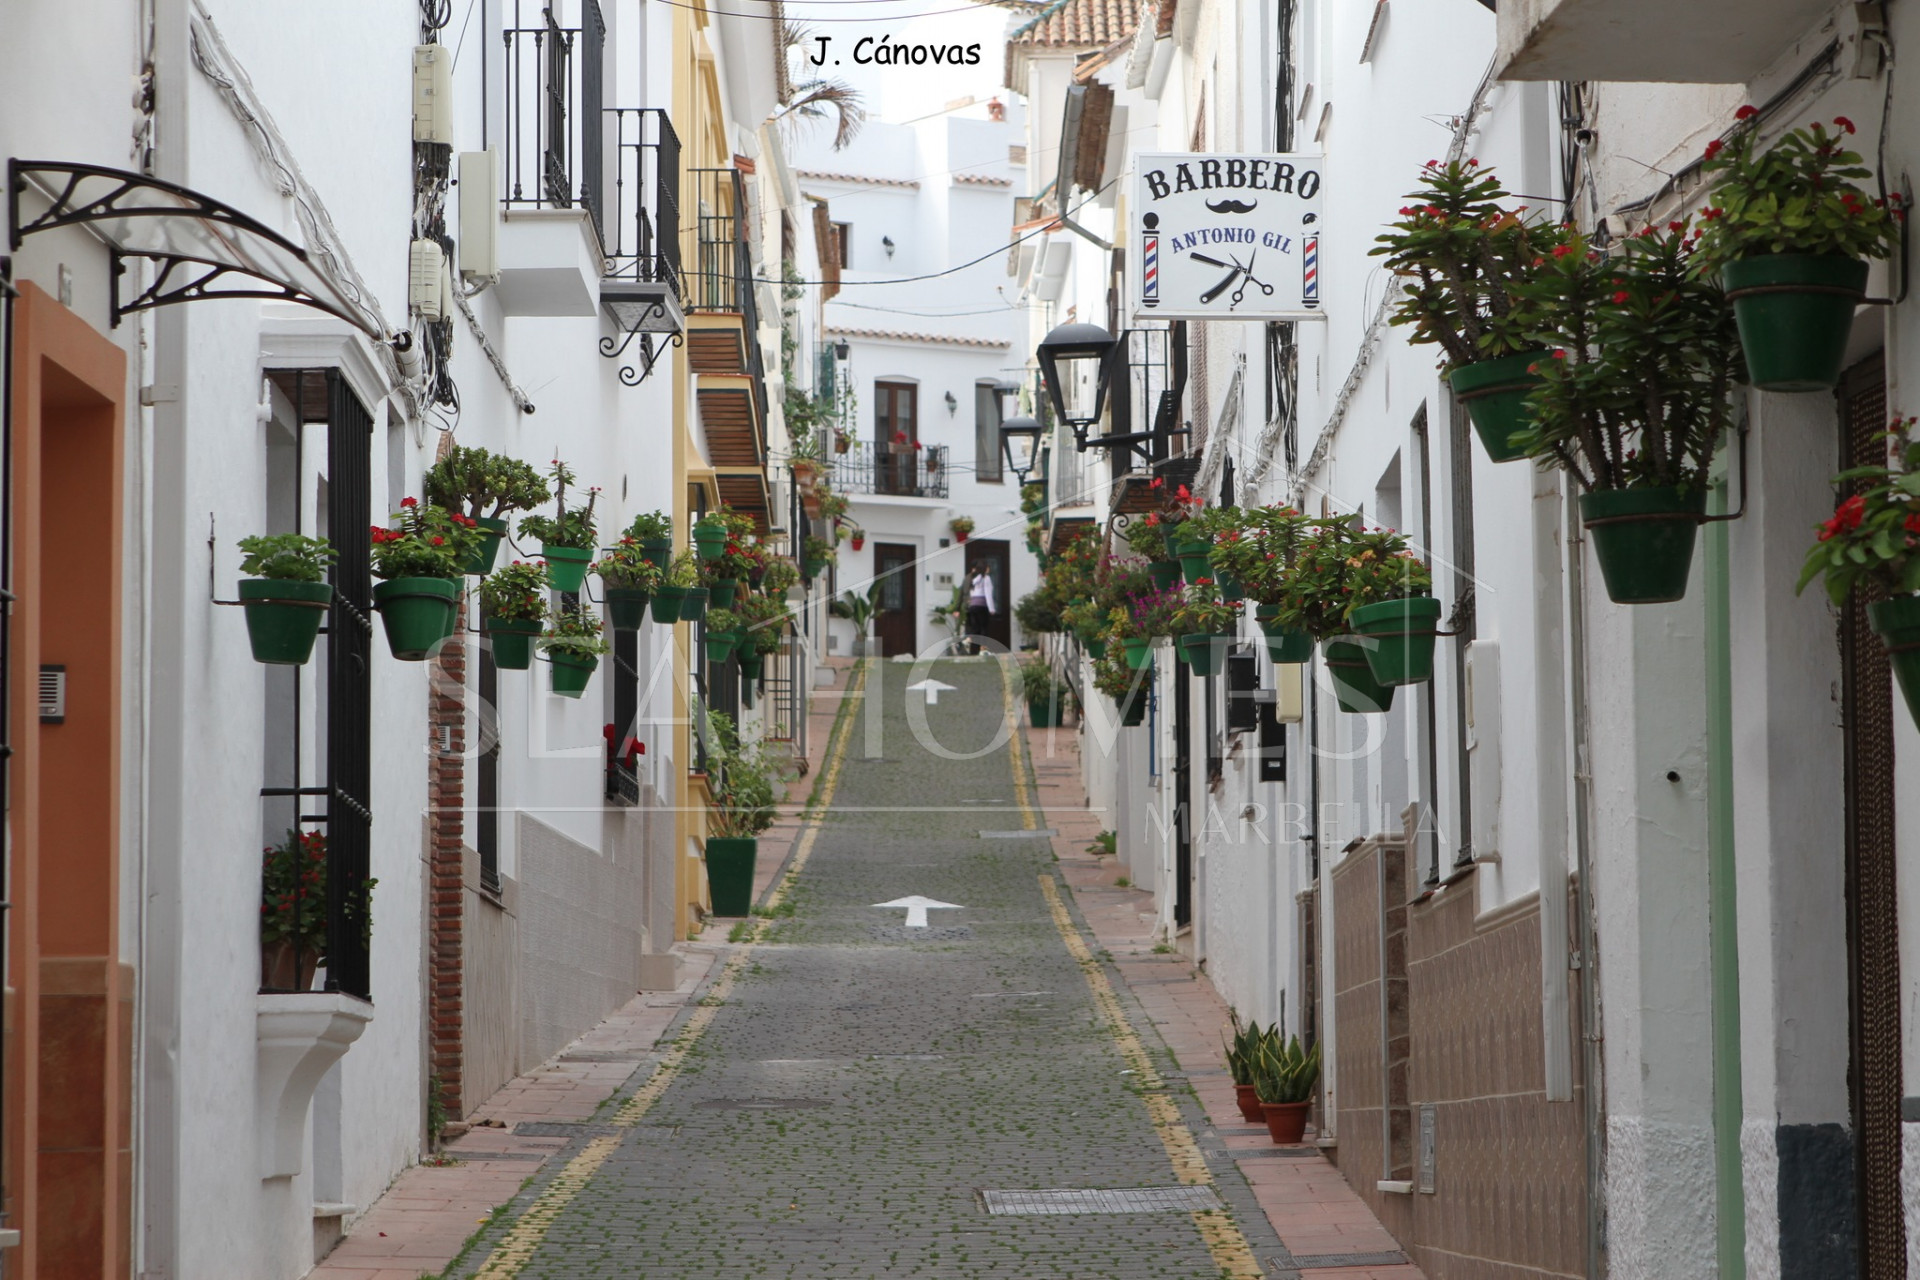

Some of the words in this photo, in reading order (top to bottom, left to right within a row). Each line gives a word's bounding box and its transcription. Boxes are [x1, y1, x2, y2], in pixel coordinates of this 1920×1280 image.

[1143, 158, 1320, 201] BARBERO
[1171, 227, 1256, 254] ANTONIO
[1262, 231, 1292, 255] GIL
